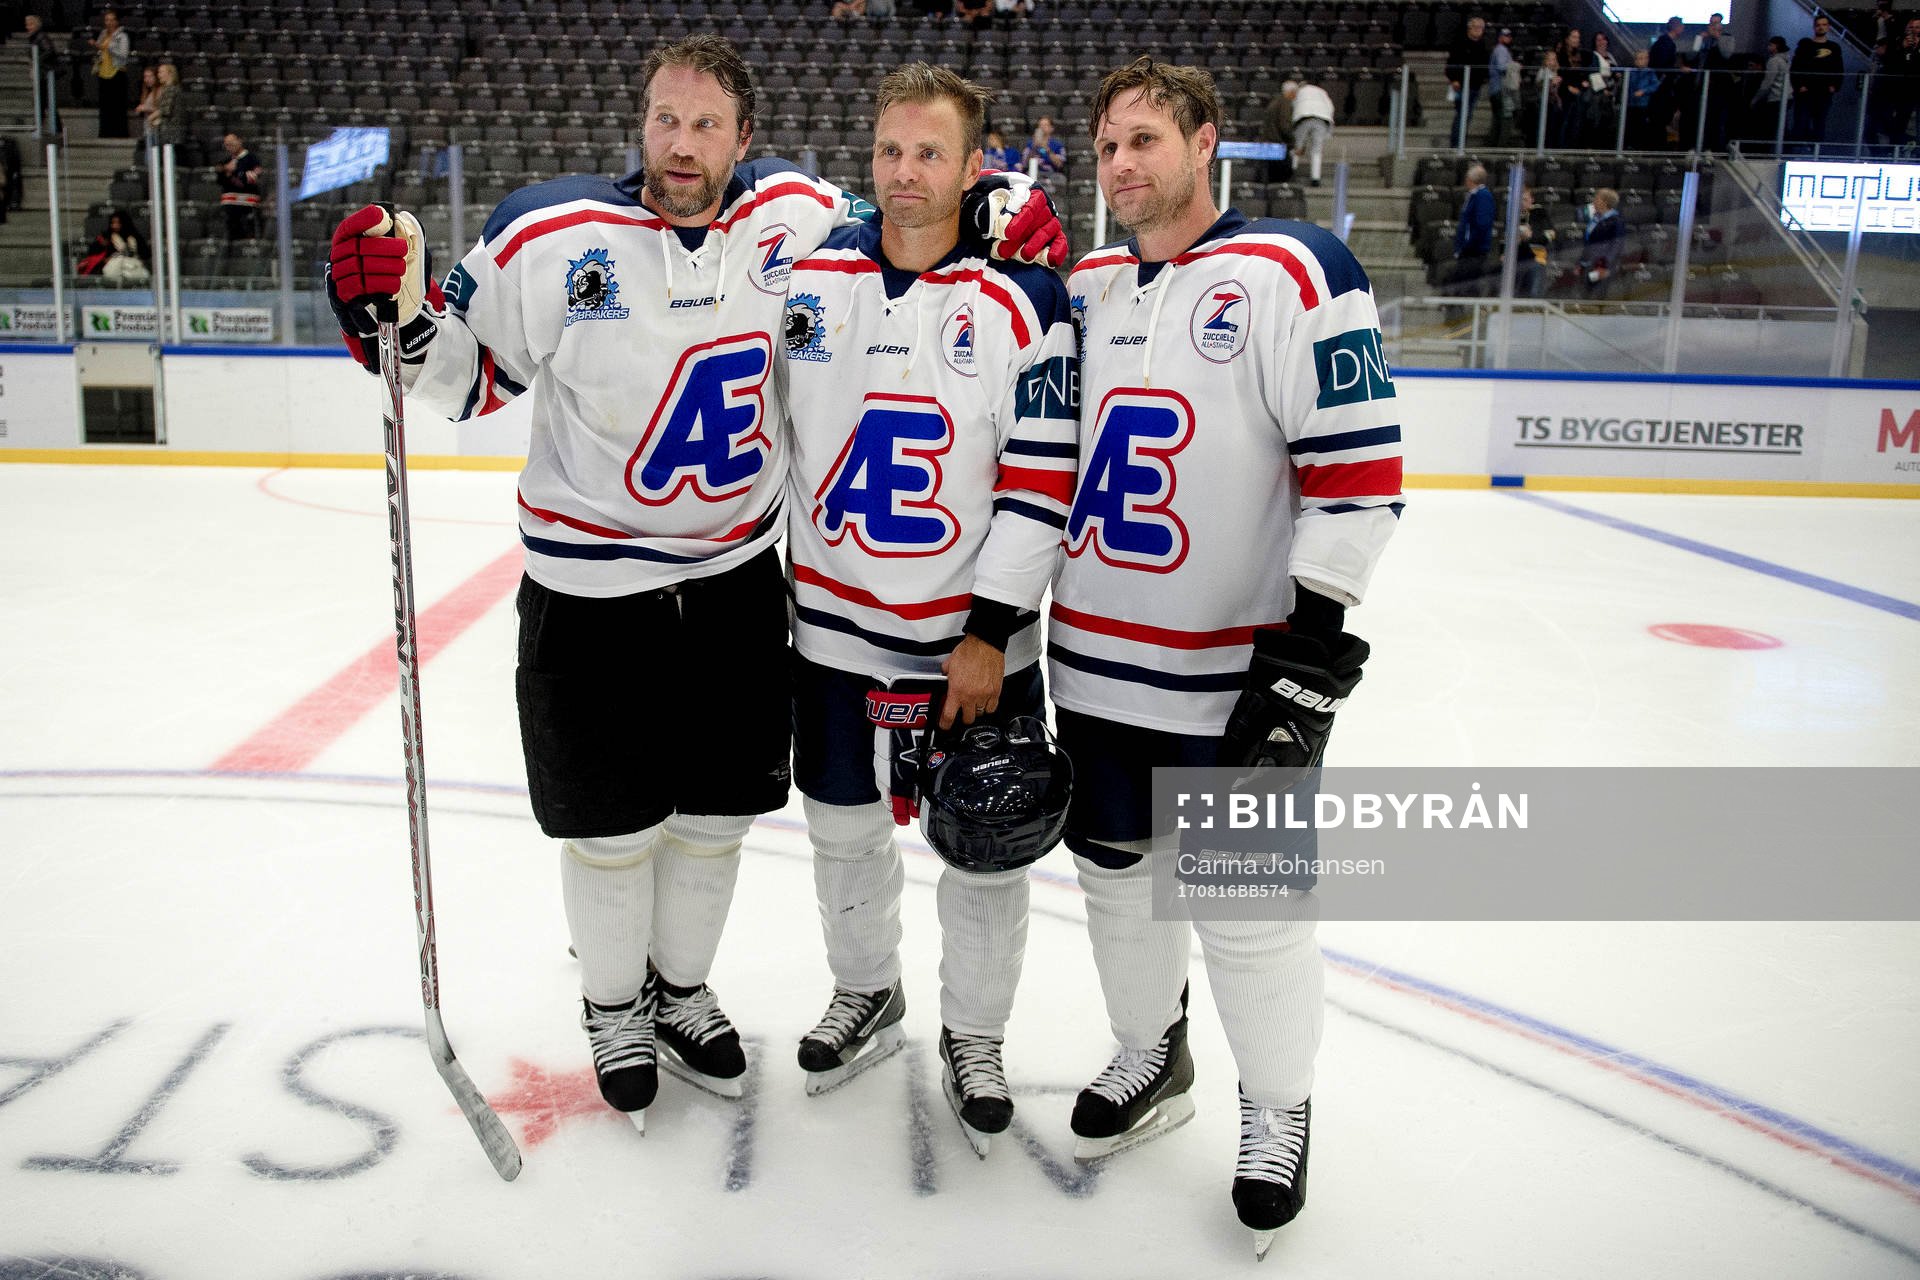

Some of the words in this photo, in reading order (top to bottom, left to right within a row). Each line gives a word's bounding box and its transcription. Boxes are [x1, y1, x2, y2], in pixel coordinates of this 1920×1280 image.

[1787, 168, 1920, 201] modu
[565, 308, 629, 326] ICEBREAKERS
[406, 325, 436, 349] BAUER
[866, 344, 909, 355] BUER
[1516, 416, 1551, 440] TS
[1560, 418, 1804, 447] BYGGTJENESTER
[382, 413, 410, 668] EASTON
[1270, 678, 1348, 712] BAU
[866, 697, 930, 724] UER
